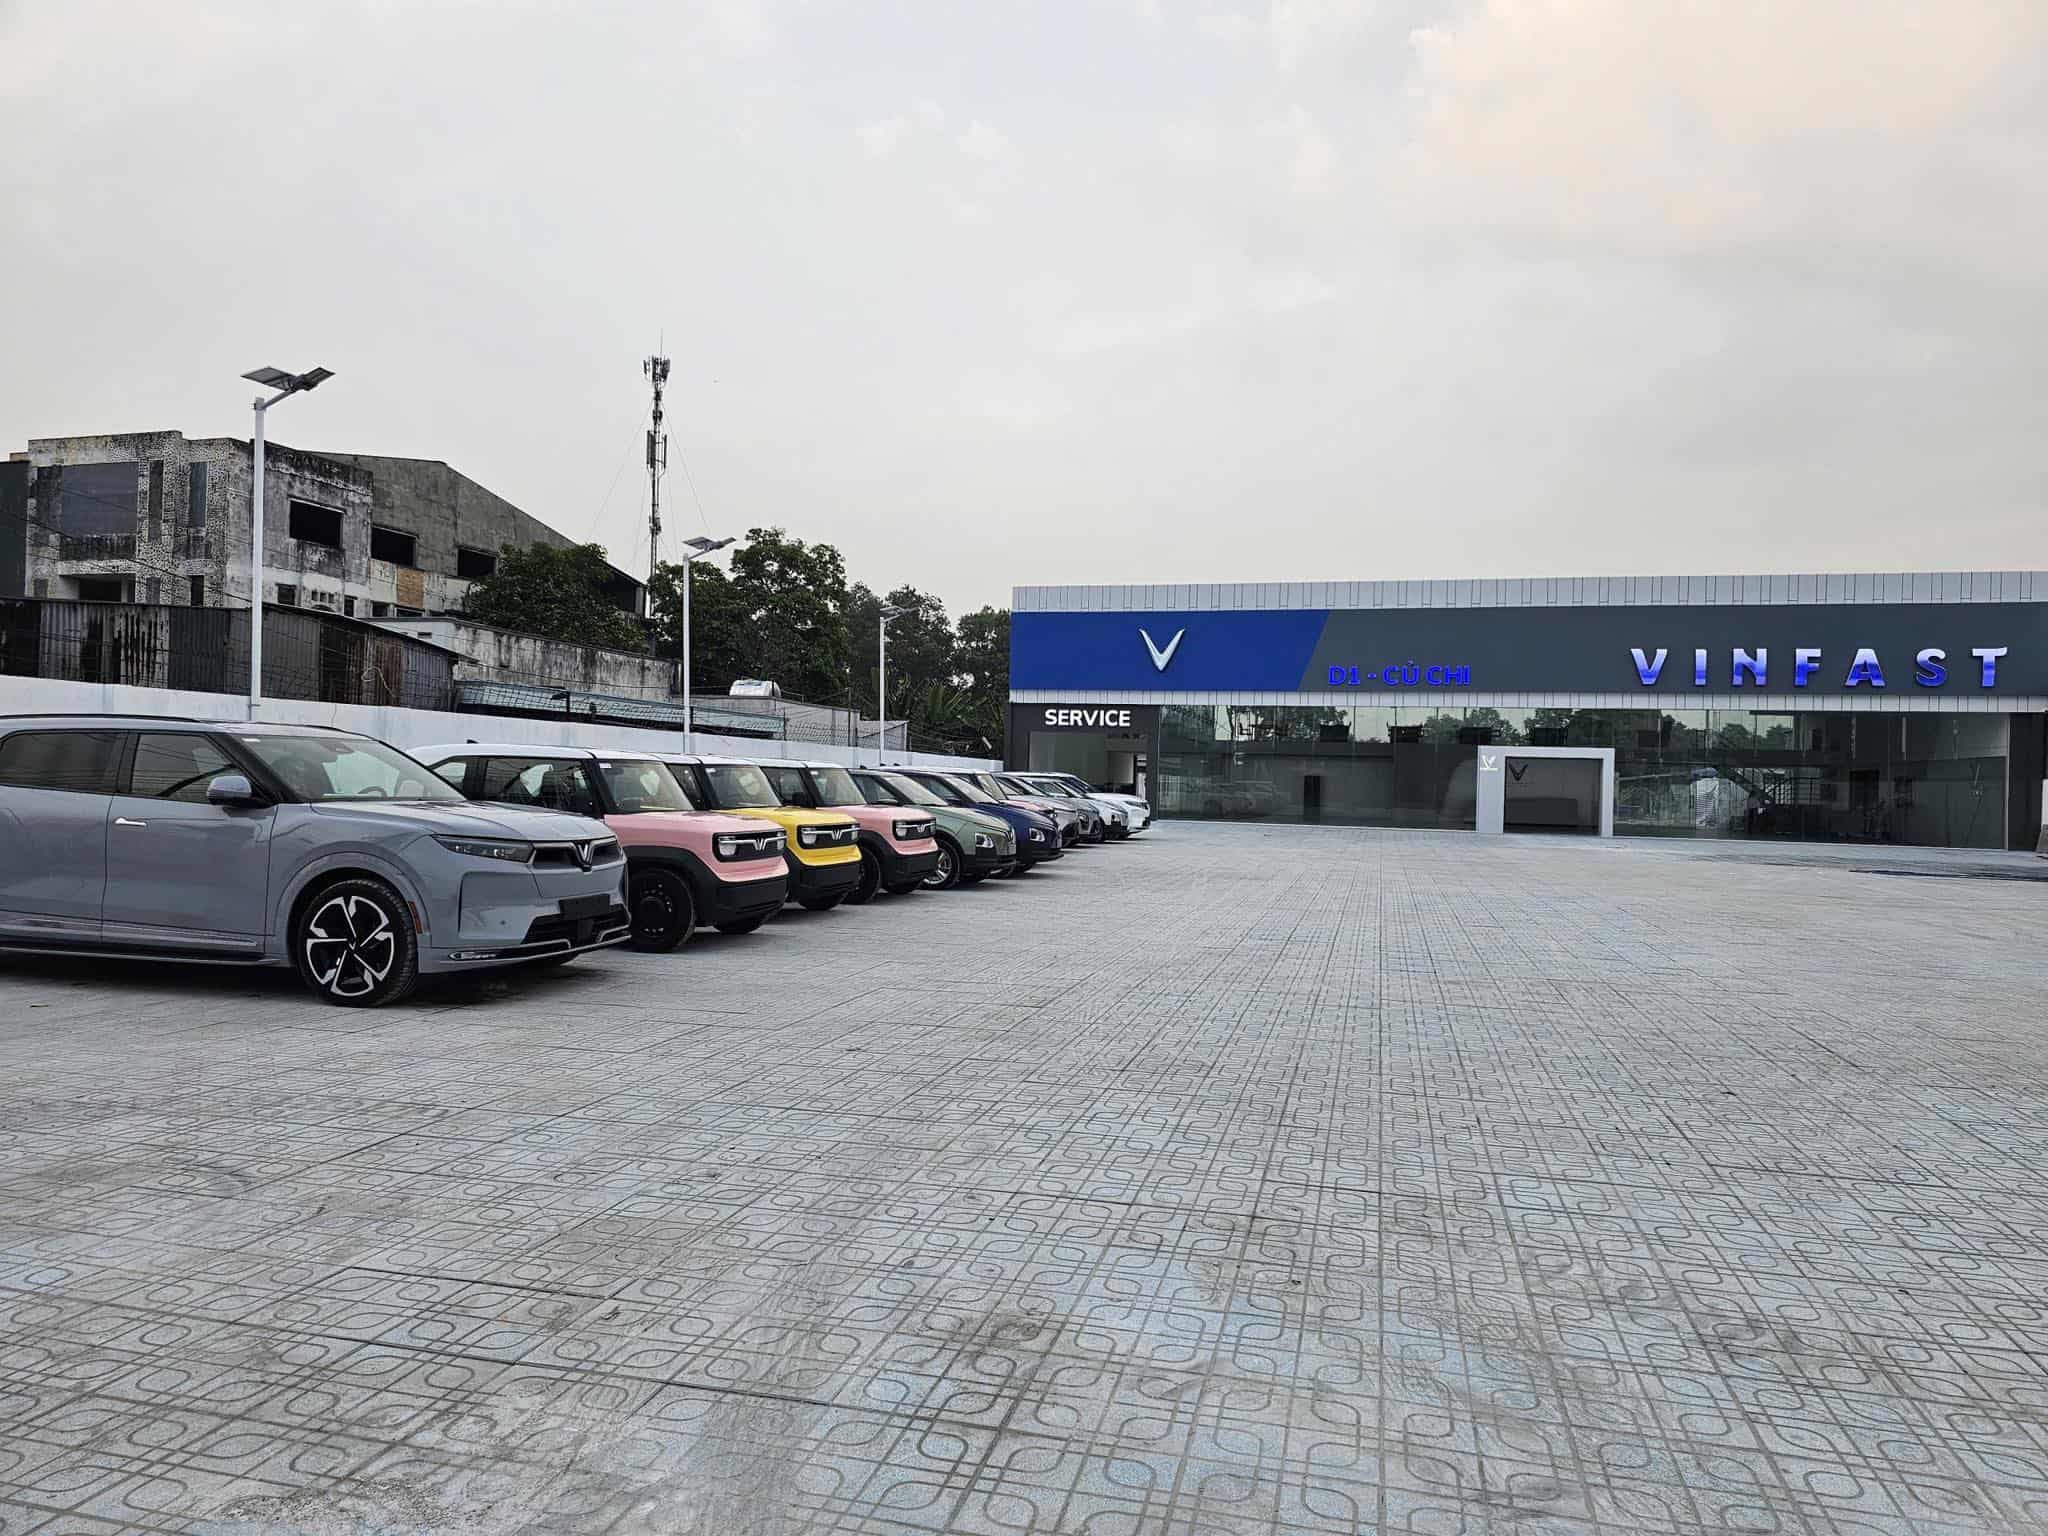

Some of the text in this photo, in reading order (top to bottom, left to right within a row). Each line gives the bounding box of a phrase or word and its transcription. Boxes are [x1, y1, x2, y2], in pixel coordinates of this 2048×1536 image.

[1328, 664, 1361, 686] D1
[1426, 664, 1472, 687] CHI
[1630, 647, 2008, 688] VINFAST
[1044, 708, 1132, 727] SERVICE
